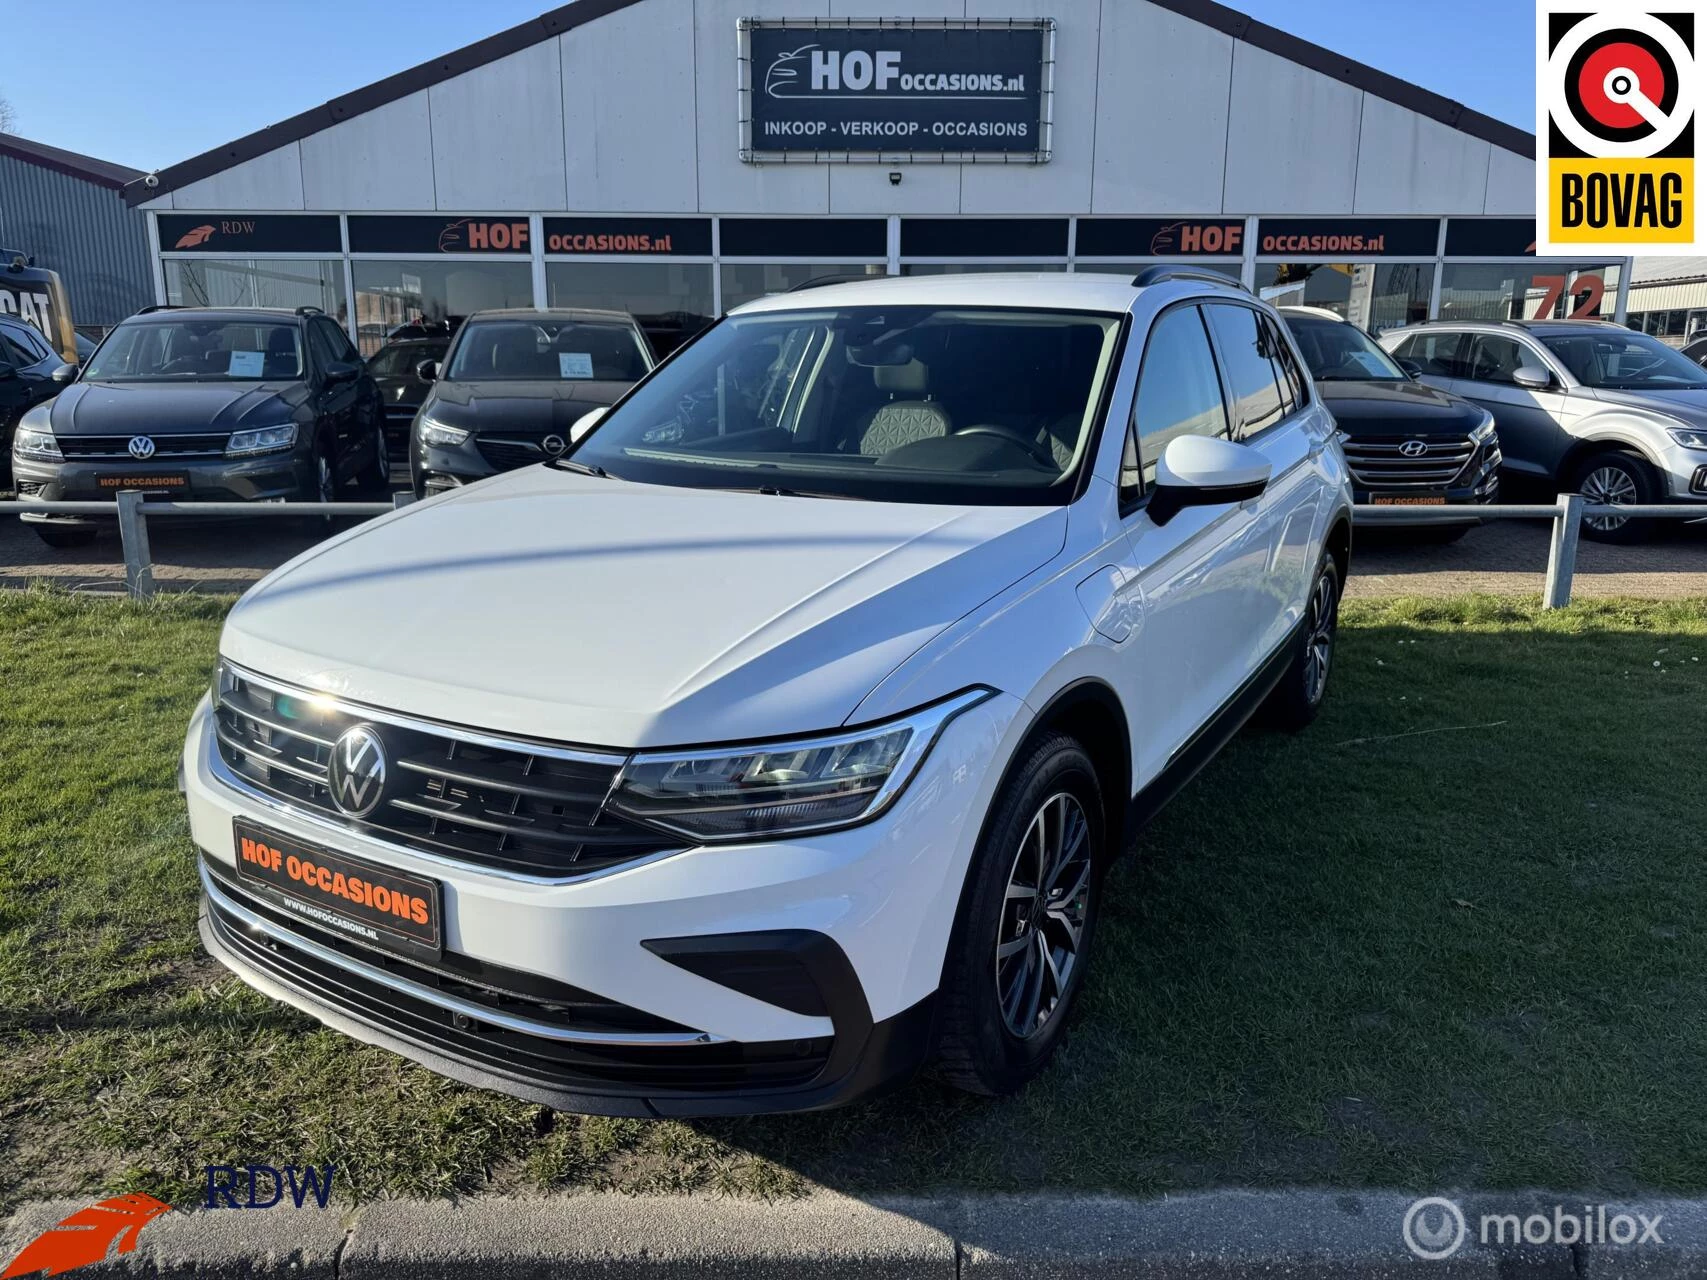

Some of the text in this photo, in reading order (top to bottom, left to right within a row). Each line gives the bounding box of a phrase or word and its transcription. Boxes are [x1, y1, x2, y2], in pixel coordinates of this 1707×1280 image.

[811, 50, 1025, 92] HOF OCCASIONS.nl
[765, 121, 1027, 137] INKOOP VERKOOP OCCASIONS
[221, 220, 256, 234] RDW
[468, 223, 672, 251] HOF OCCASIONS.nl
[1181, 226, 1385, 251] HOF OCCASIONS.nl
[1530, 274, 1605, 320] 72
[100, 477, 185, 487] HOF OCCASIONS
[1394, 497, 1445, 505] OCCASIONS
[241, 837, 429, 924] HOF OCCASIONS
[283, 897, 379, 941] WWW.HOFOCCASIONS.NL
